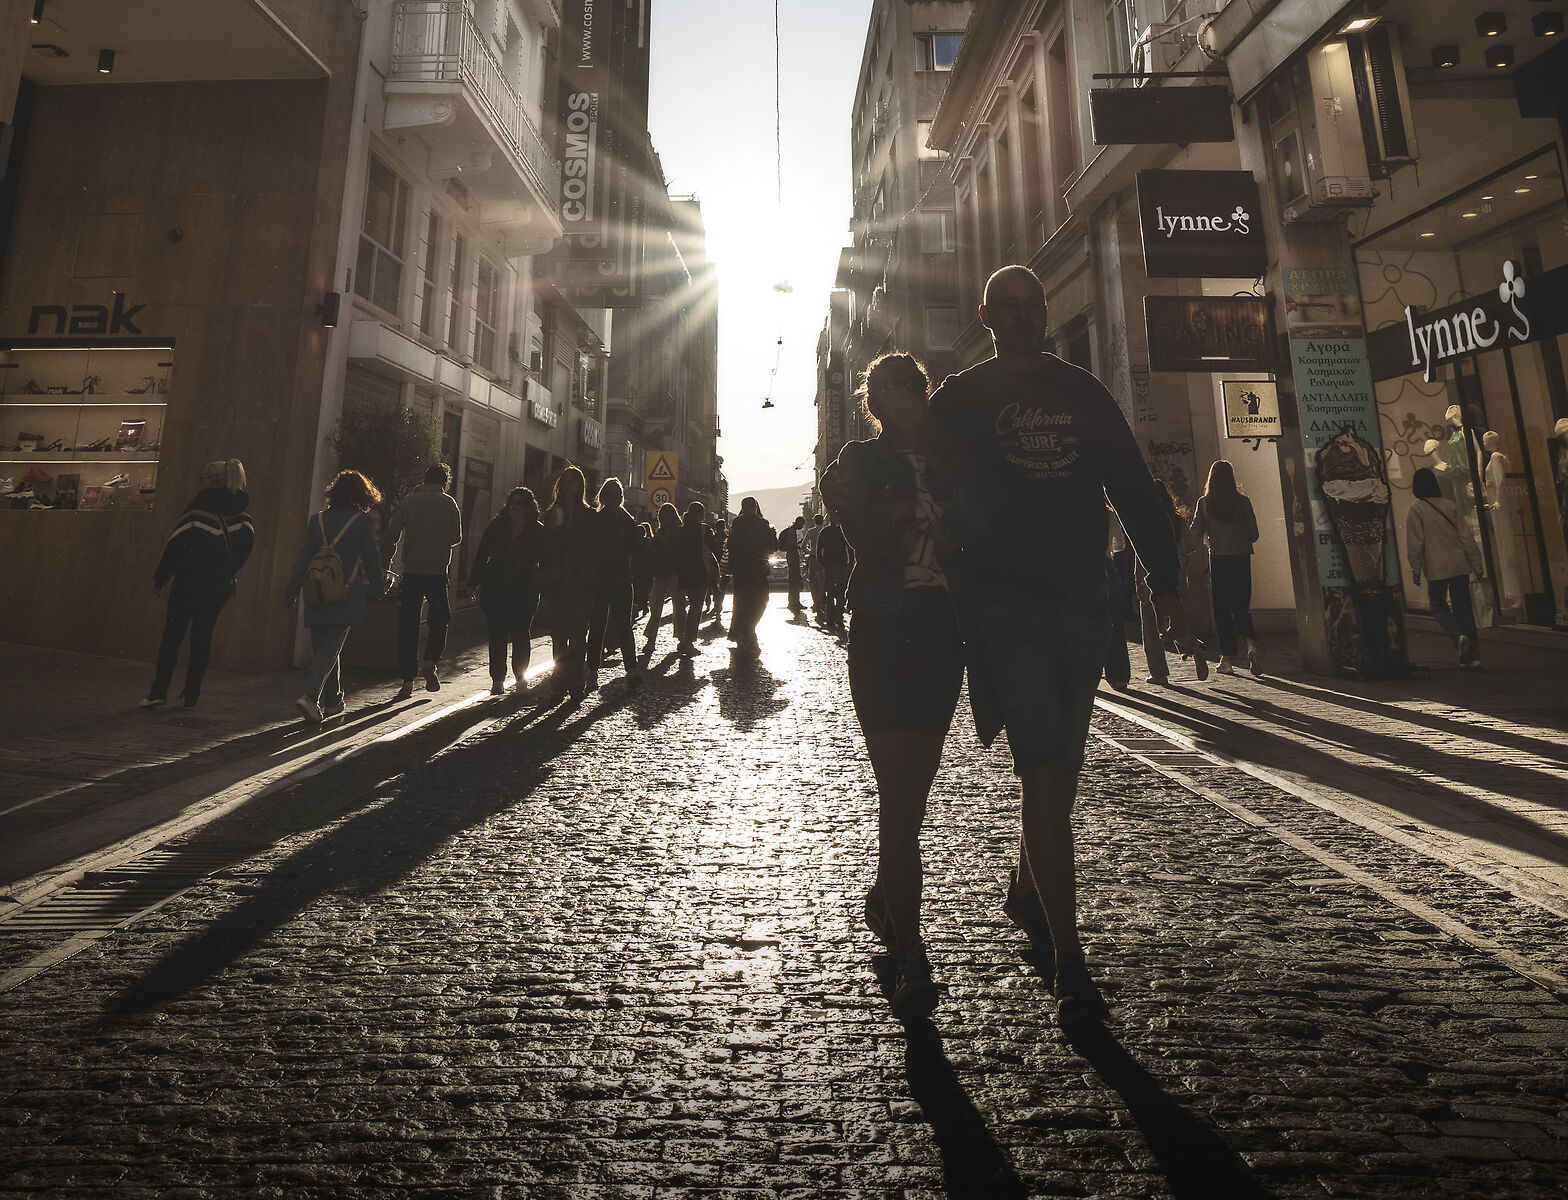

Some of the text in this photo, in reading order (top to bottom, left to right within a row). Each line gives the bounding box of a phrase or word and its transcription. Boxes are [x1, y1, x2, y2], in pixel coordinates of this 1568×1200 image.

[590, 93, 598, 124] SPORT
[562, 92, 591, 222] COSMOS
[1156, 205, 1232, 238] lynne
[28, 293, 147, 334] nak
[1306, 340, 1350, 355] Αγορά
[1404, 304, 1500, 383] lynne
[1301, 393, 1368, 402] ΑΝΤΑΛΛΑΓΗ
[994, 402, 1073, 435] California
[1231, 416, 1278, 424] HAUSBRANDT
[1020, 434, 1059, 449] SURF
[655, 493, 668, 503] 30
